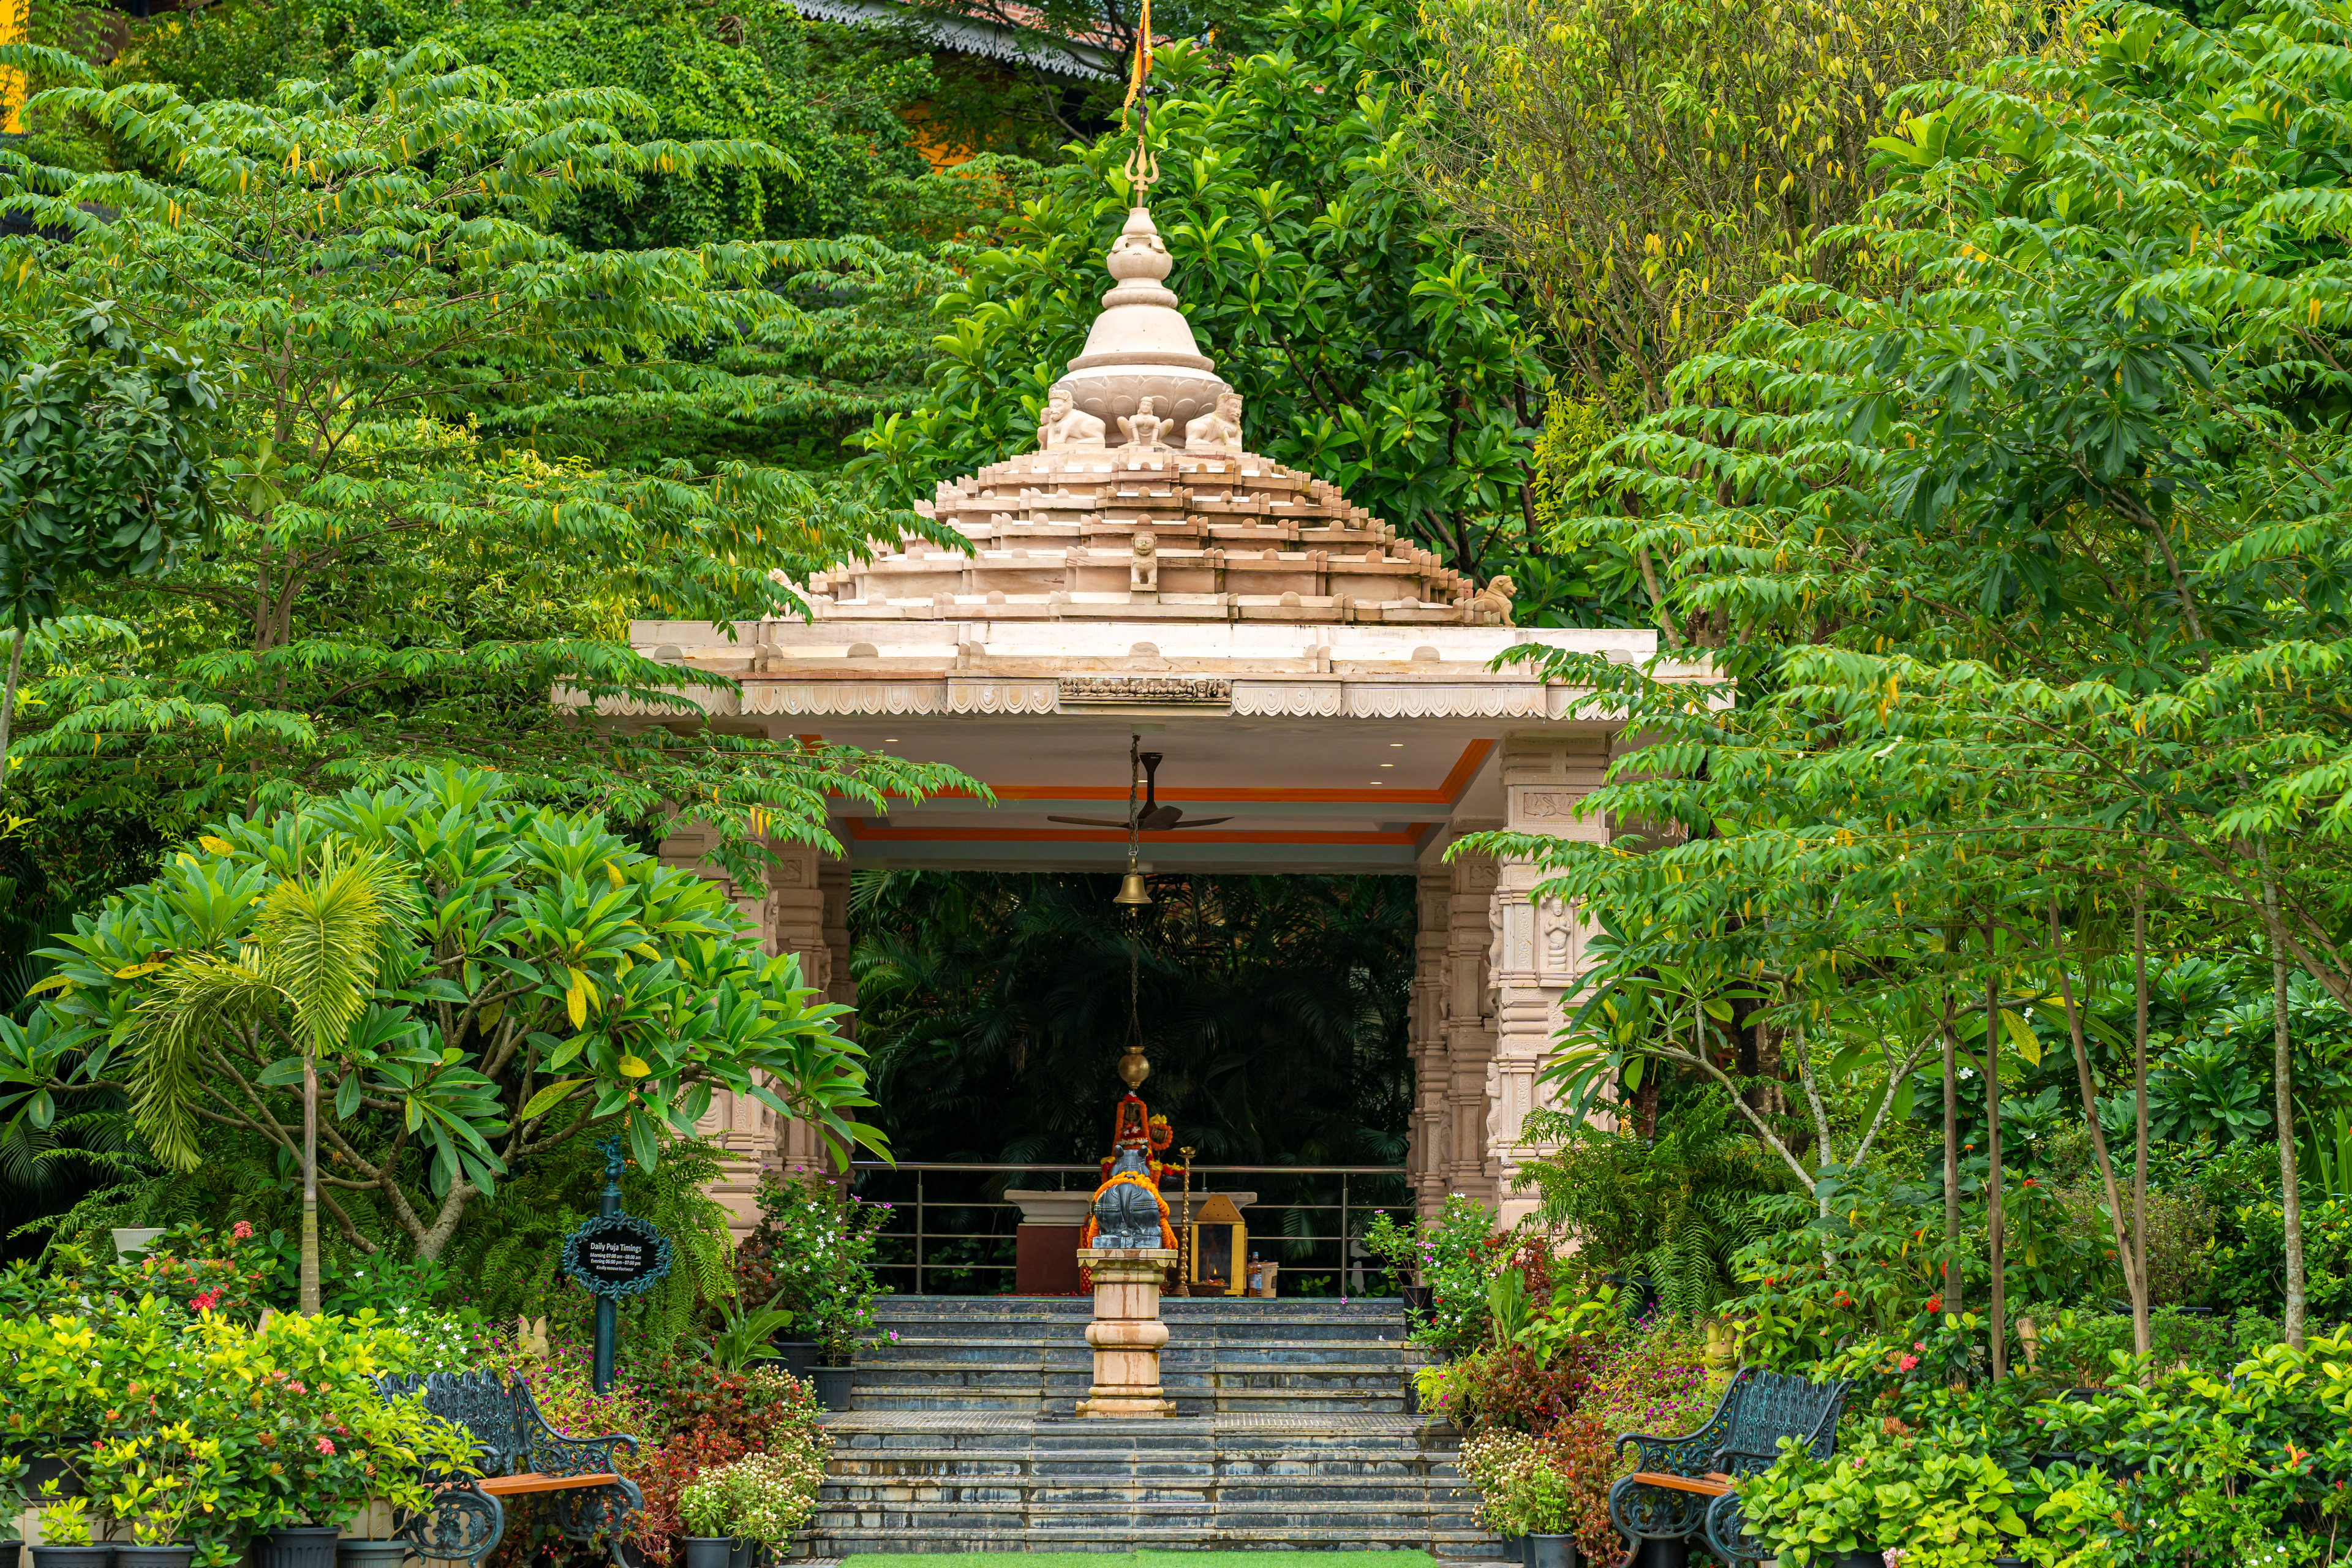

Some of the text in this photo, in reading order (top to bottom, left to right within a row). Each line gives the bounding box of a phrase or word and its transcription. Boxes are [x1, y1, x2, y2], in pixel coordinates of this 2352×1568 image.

[591, 1243, 641, 1253] Daily Puja Timings
